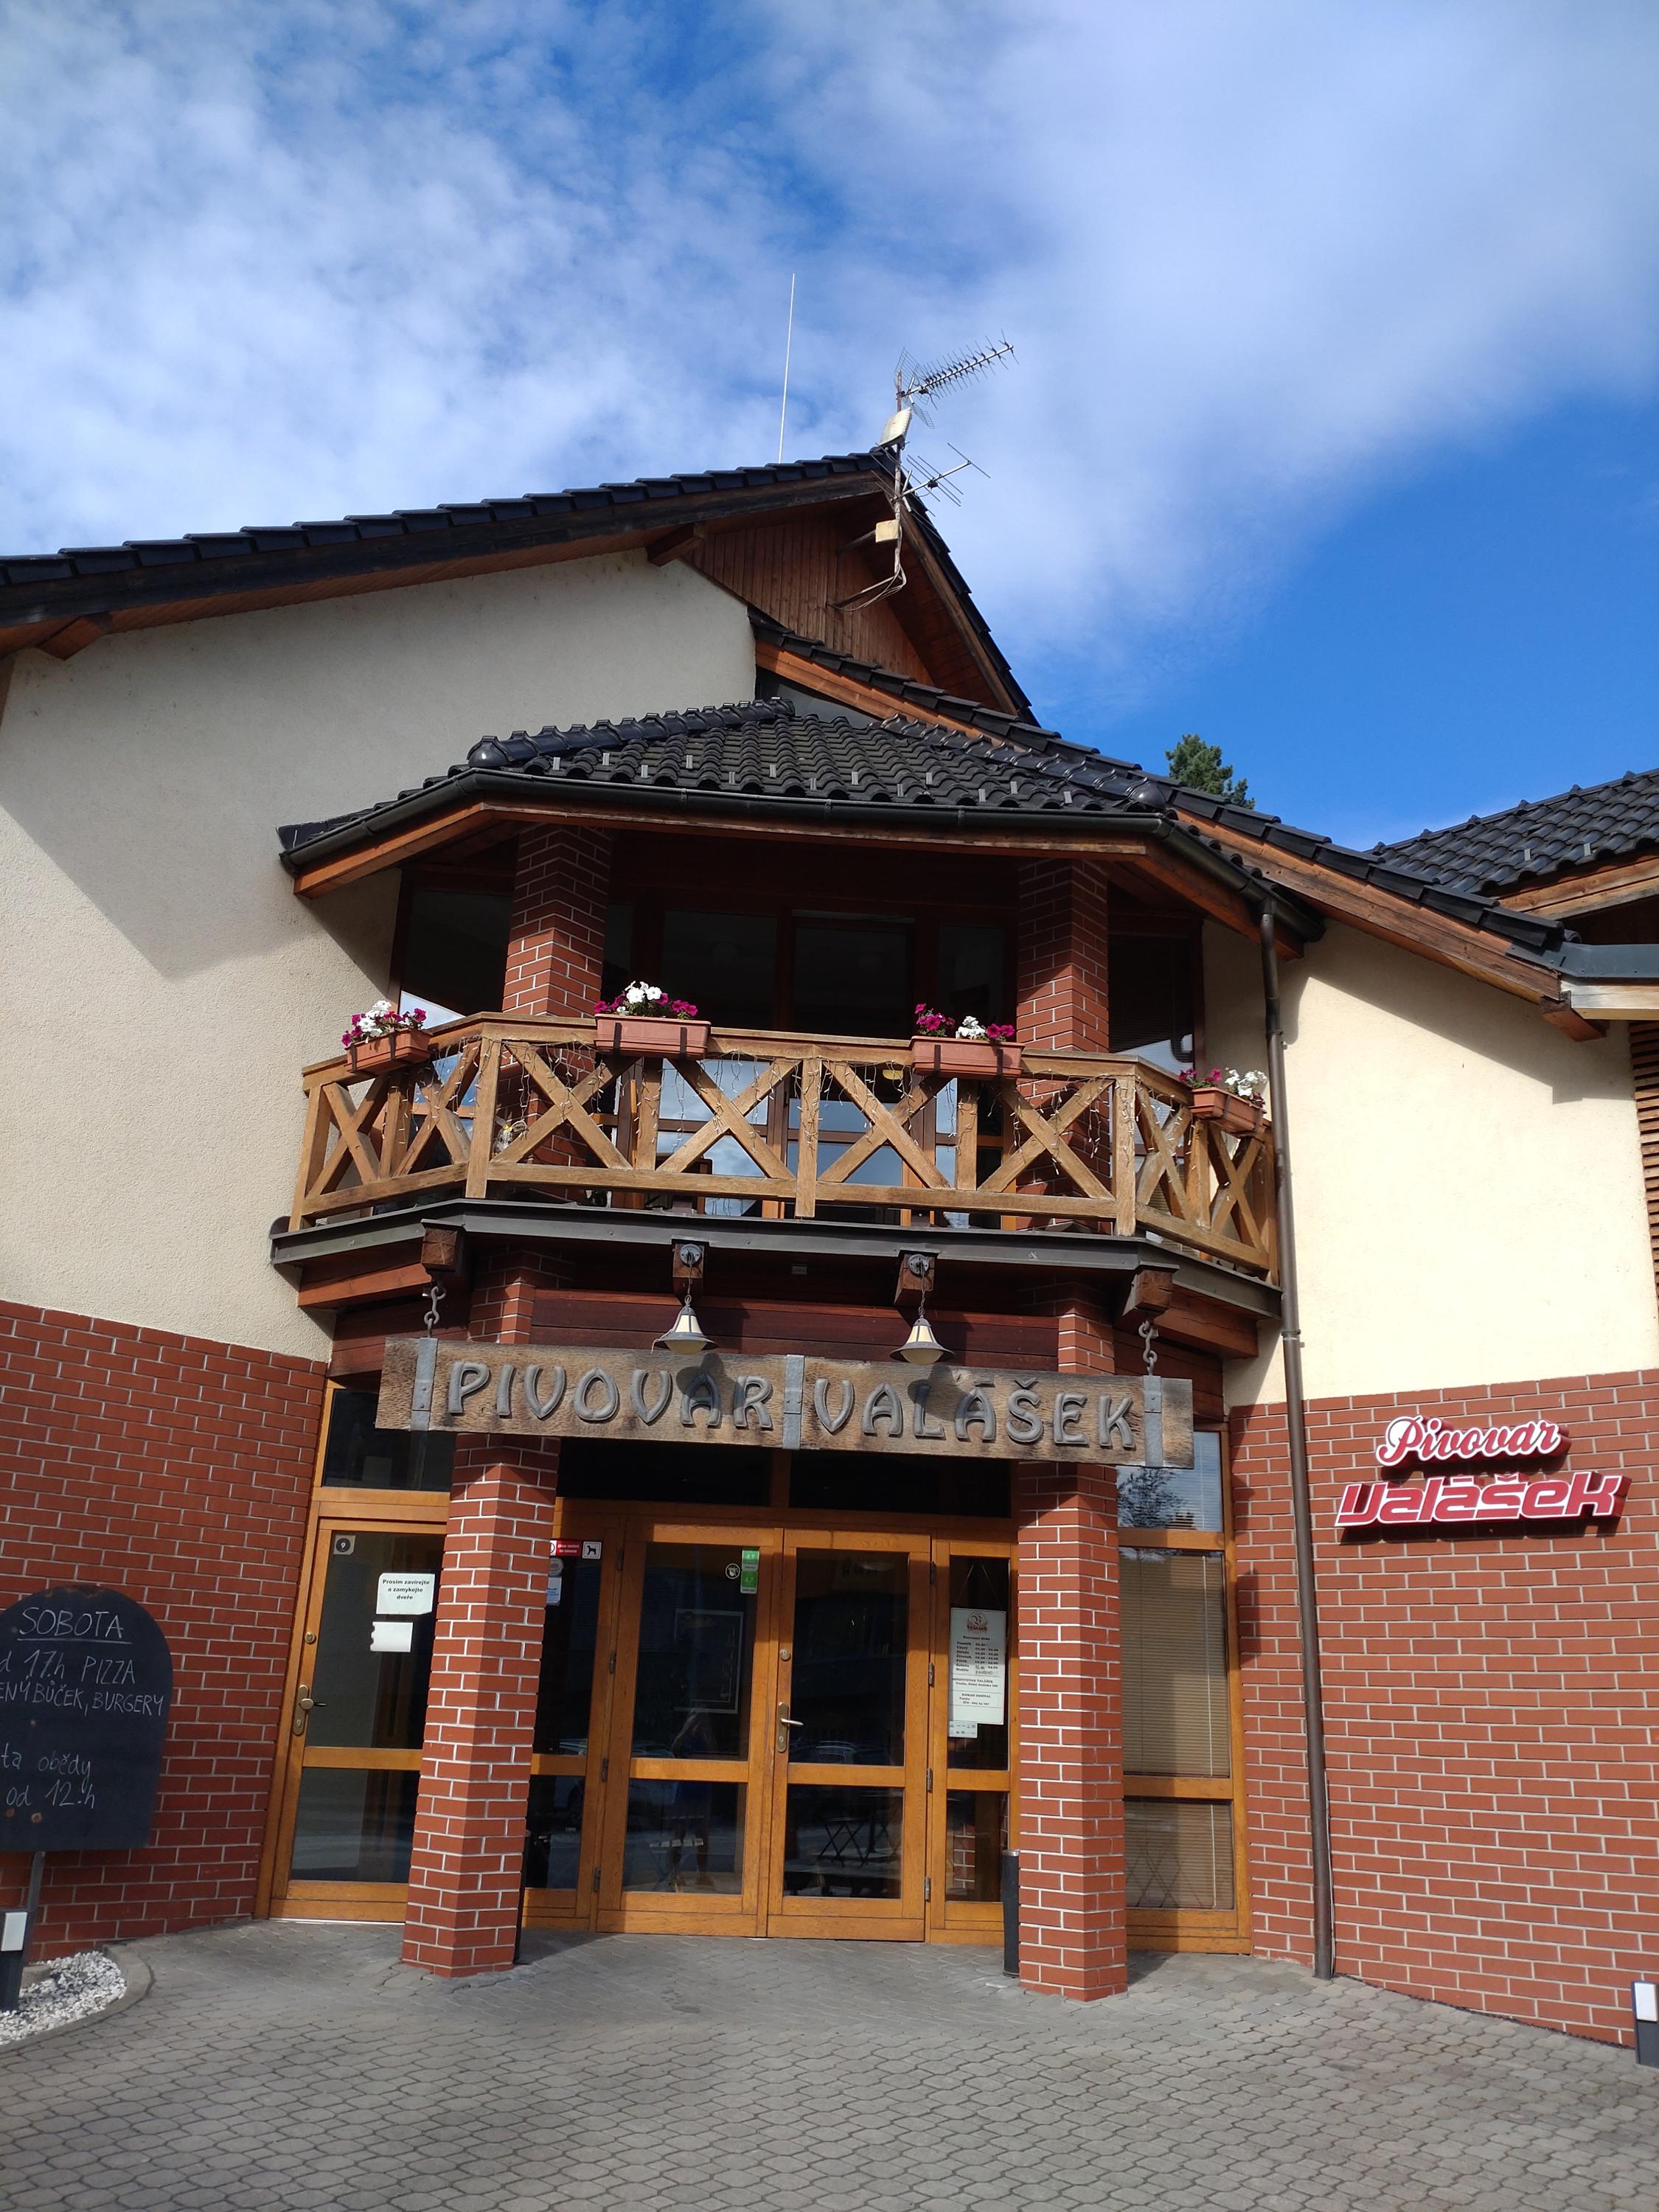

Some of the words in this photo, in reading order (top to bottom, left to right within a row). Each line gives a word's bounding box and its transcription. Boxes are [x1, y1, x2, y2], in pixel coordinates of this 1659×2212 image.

[448, 1360, 773, 1430] PIVOVAR
[813, 1376, 1136, 1450] VALÁŠEK
[1376, 1415, 1562, 1467] Pivovar
[19, 1607, 124, 1638] SOBOTA
[81, 1655, 135, 1685] PIZZA
[91, 1691, 164, 1717] BURGERY
[1, 1743, 22, 1769] ta
[38, 1750, 91, 1793] obědy
